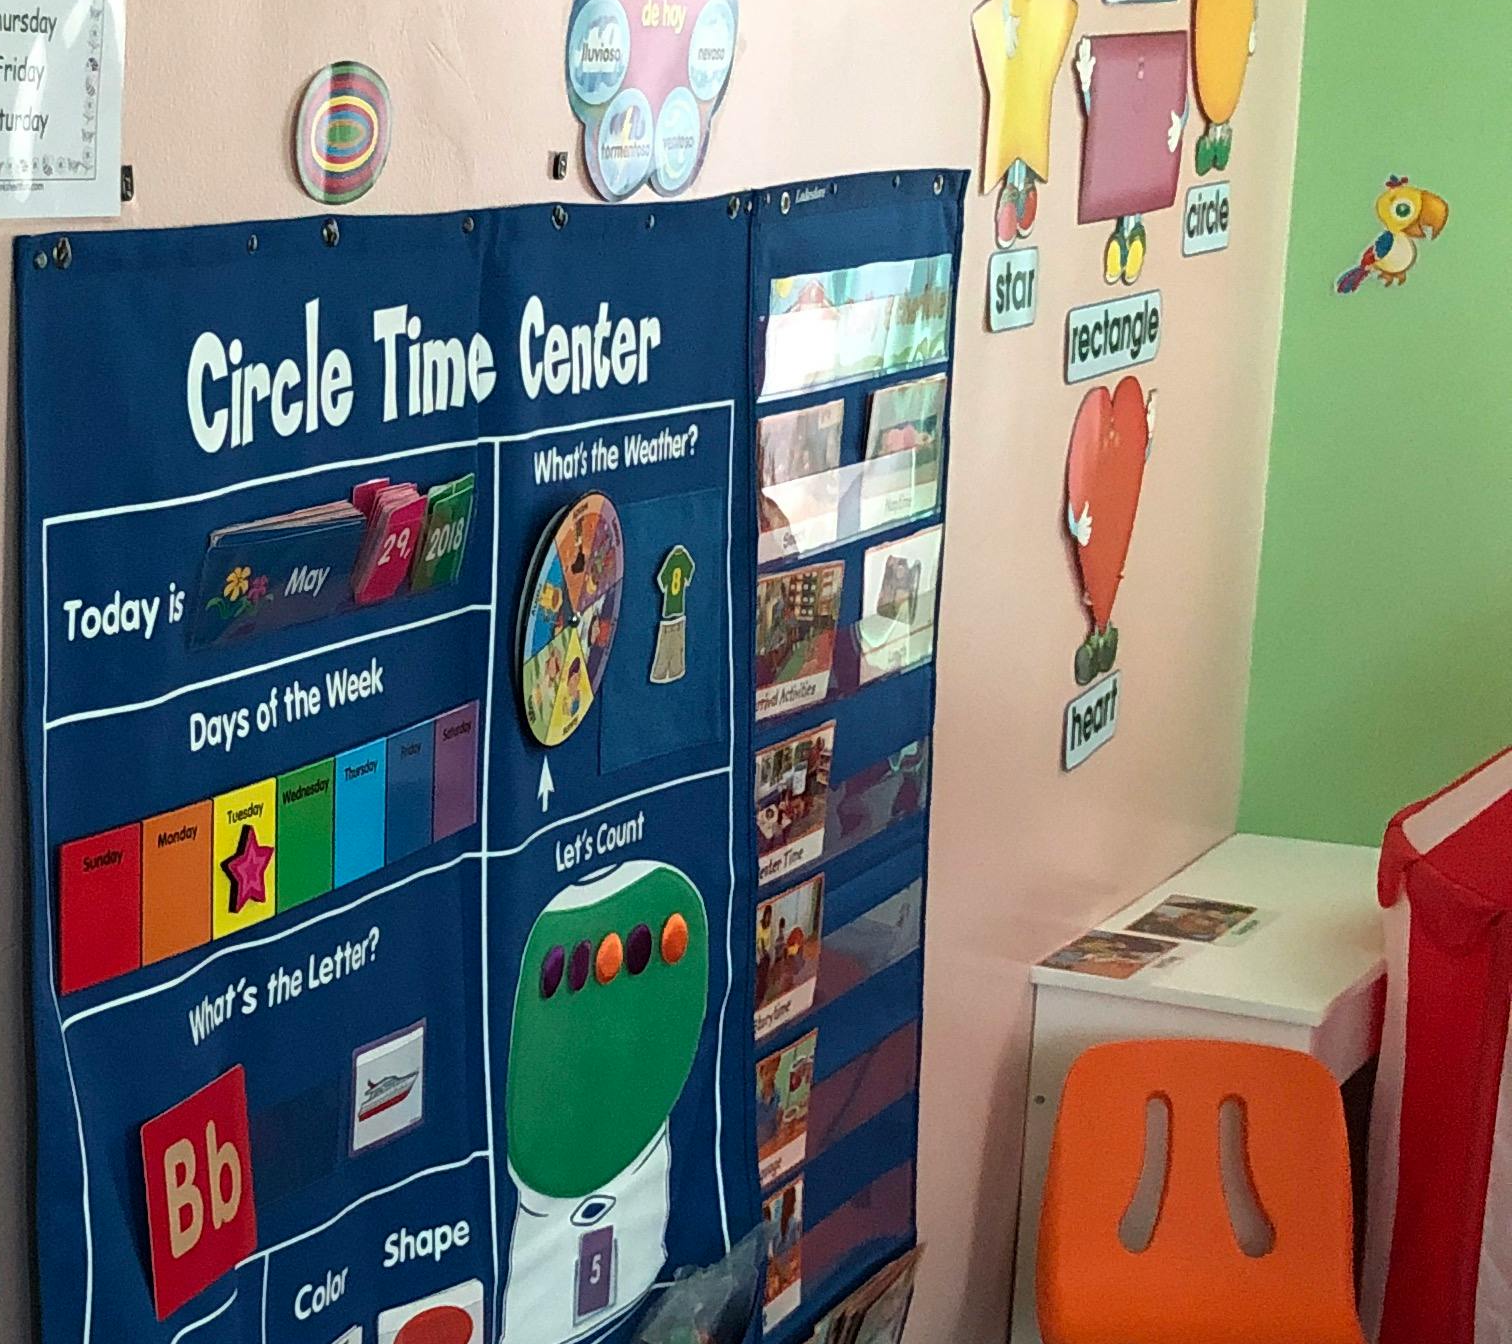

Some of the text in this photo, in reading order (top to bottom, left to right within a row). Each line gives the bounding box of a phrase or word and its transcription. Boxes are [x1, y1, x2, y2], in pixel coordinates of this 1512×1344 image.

[661, 0, 687, 35] hoy
[1187, 194, 1229, 238] circle
[995, 261, 1036, 315] star
[1070, 302, 1159, 367] rectangle
[187, 295, 661, 453] Circle Time Center
[534, 424, 699, 485] What's the Weather?
[424, 516, 466, 562] 2018
[284, 564, 330, 598] May
[671, 567, 682, 596] 8
[63, 582, 186, 642] Today is
[190, 657, 384, 752] Days of the Week
[1071, 681, 1119, 751] heart
[281, 778, 330, 805] Wednesday
[343, 759, 378, 782] Thursday
[156, 823, 198, 849] Monday
[227, 801, 265, 825] Tuesday
[82, 849, 124, 873] Sunday
[554, 810, 645, 873] Let's Count
[189, 926, 380, 1046] What's the Letter?
[164, 1119, 242, 1259] Bb
[383, 1219, 470, 1269] Shape
[293, 1265, 349, 1321] Color
[590, 1253, 602, 1286] 5
